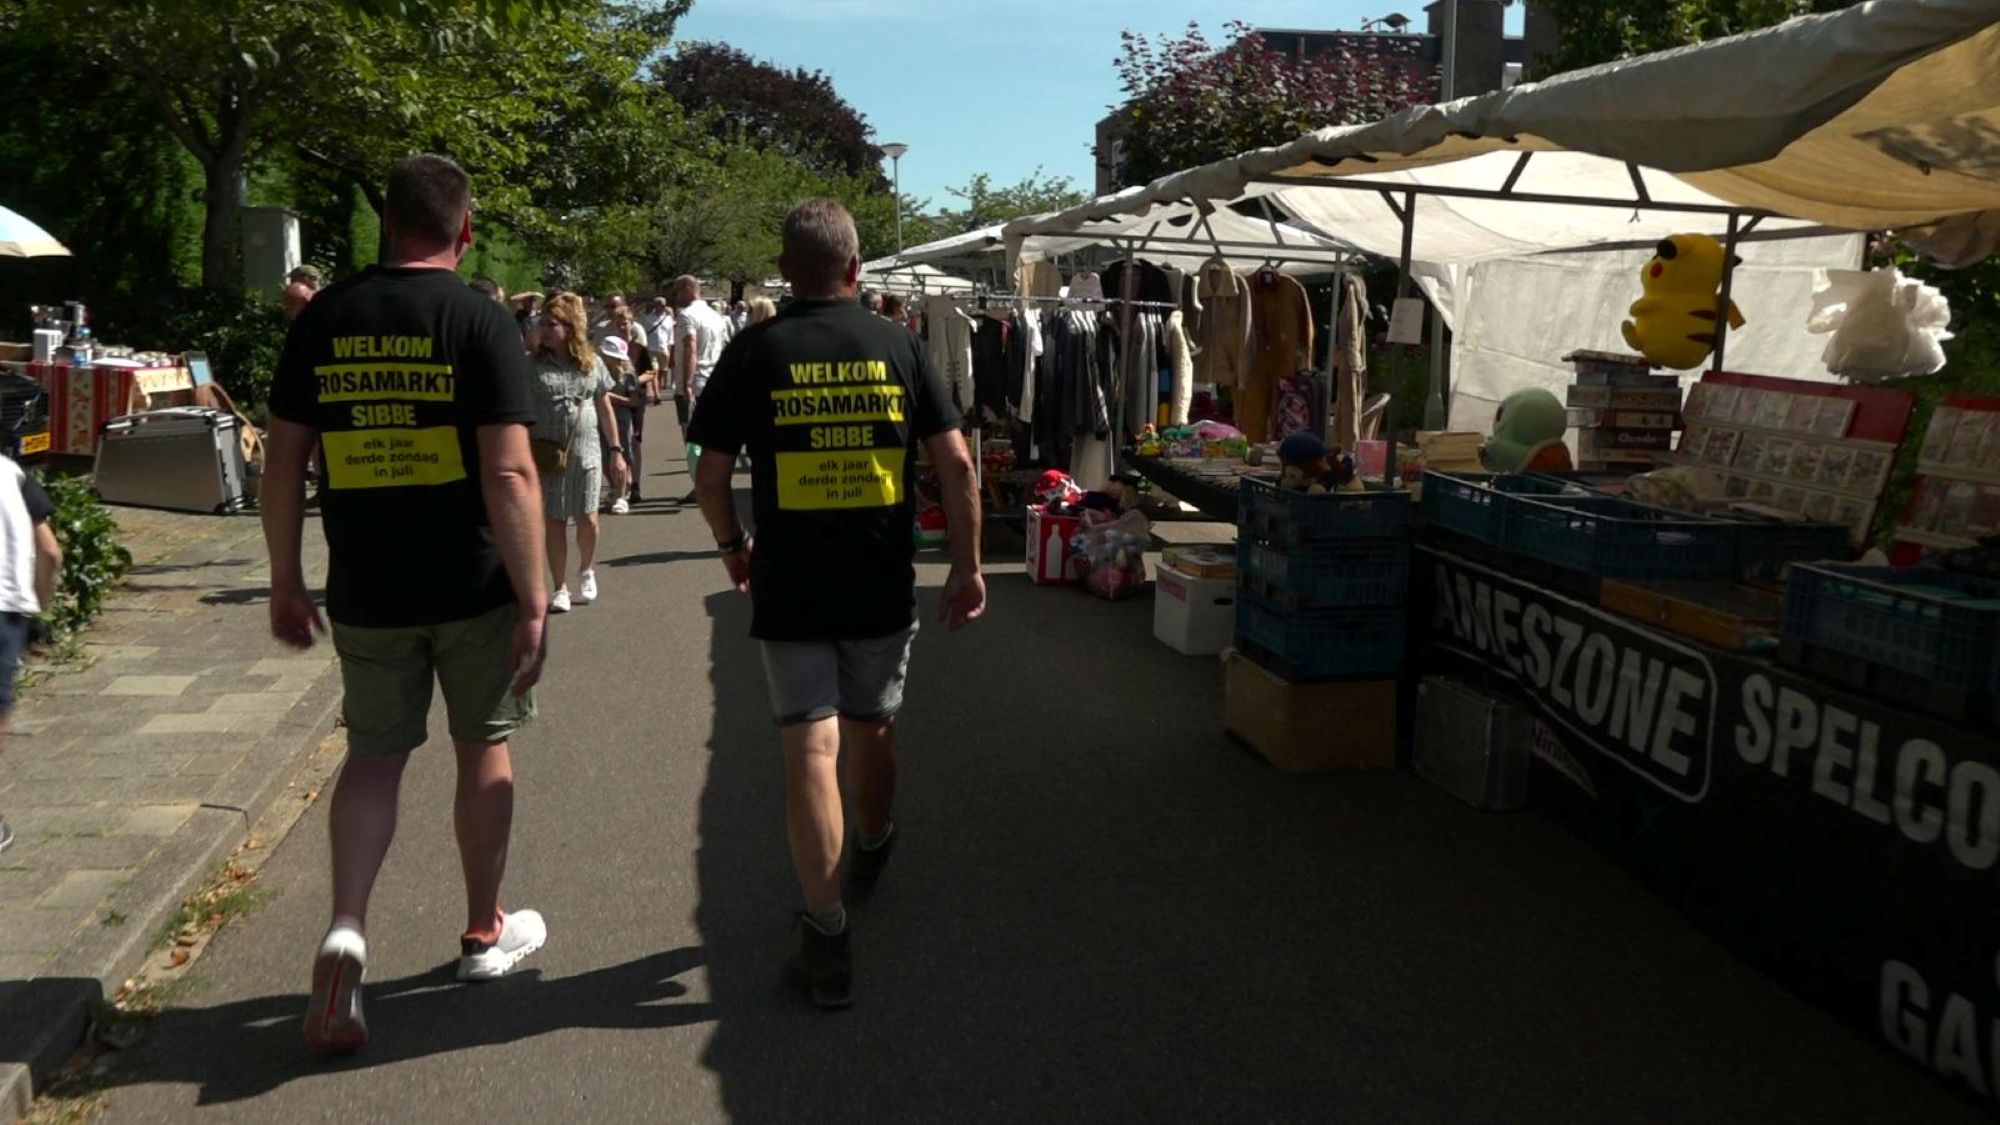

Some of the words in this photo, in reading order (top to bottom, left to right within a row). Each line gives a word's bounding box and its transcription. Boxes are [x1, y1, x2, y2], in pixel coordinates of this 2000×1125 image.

[332, 336, 433, 358] WELKOM
[318, 371, 456, 395] ROSAMARKT
[790, 360, 887, 384] WELKOM
[352, 404, 418, 426] SIBBE
[775, 394, 905, 417] ROSAMARKT
[363, 438, 385, 449] elk
[389, 438, 414, 451] jaar
[810, 425, 874, 448] SIBBE
[345, 451, 384, 464] derde
[389, 450, 439, 464] zondag
[819, 460, 838, 471] elk
[842, 461, 868, 473] jaar
[374, 466, 387, 477] in
[389, 465, 414, 479] juli
[799, 474, 838, 486] derde
[841, 473, 888, 486] zondag
[826, 487, 840, 498] in
[842, 486, 862, 500] juli
[1428, 562, 1705, 777] AMESZONE
[1734, 673, 2000, 870] SPELCO
[1880, 959, 2000, 1104] GA
